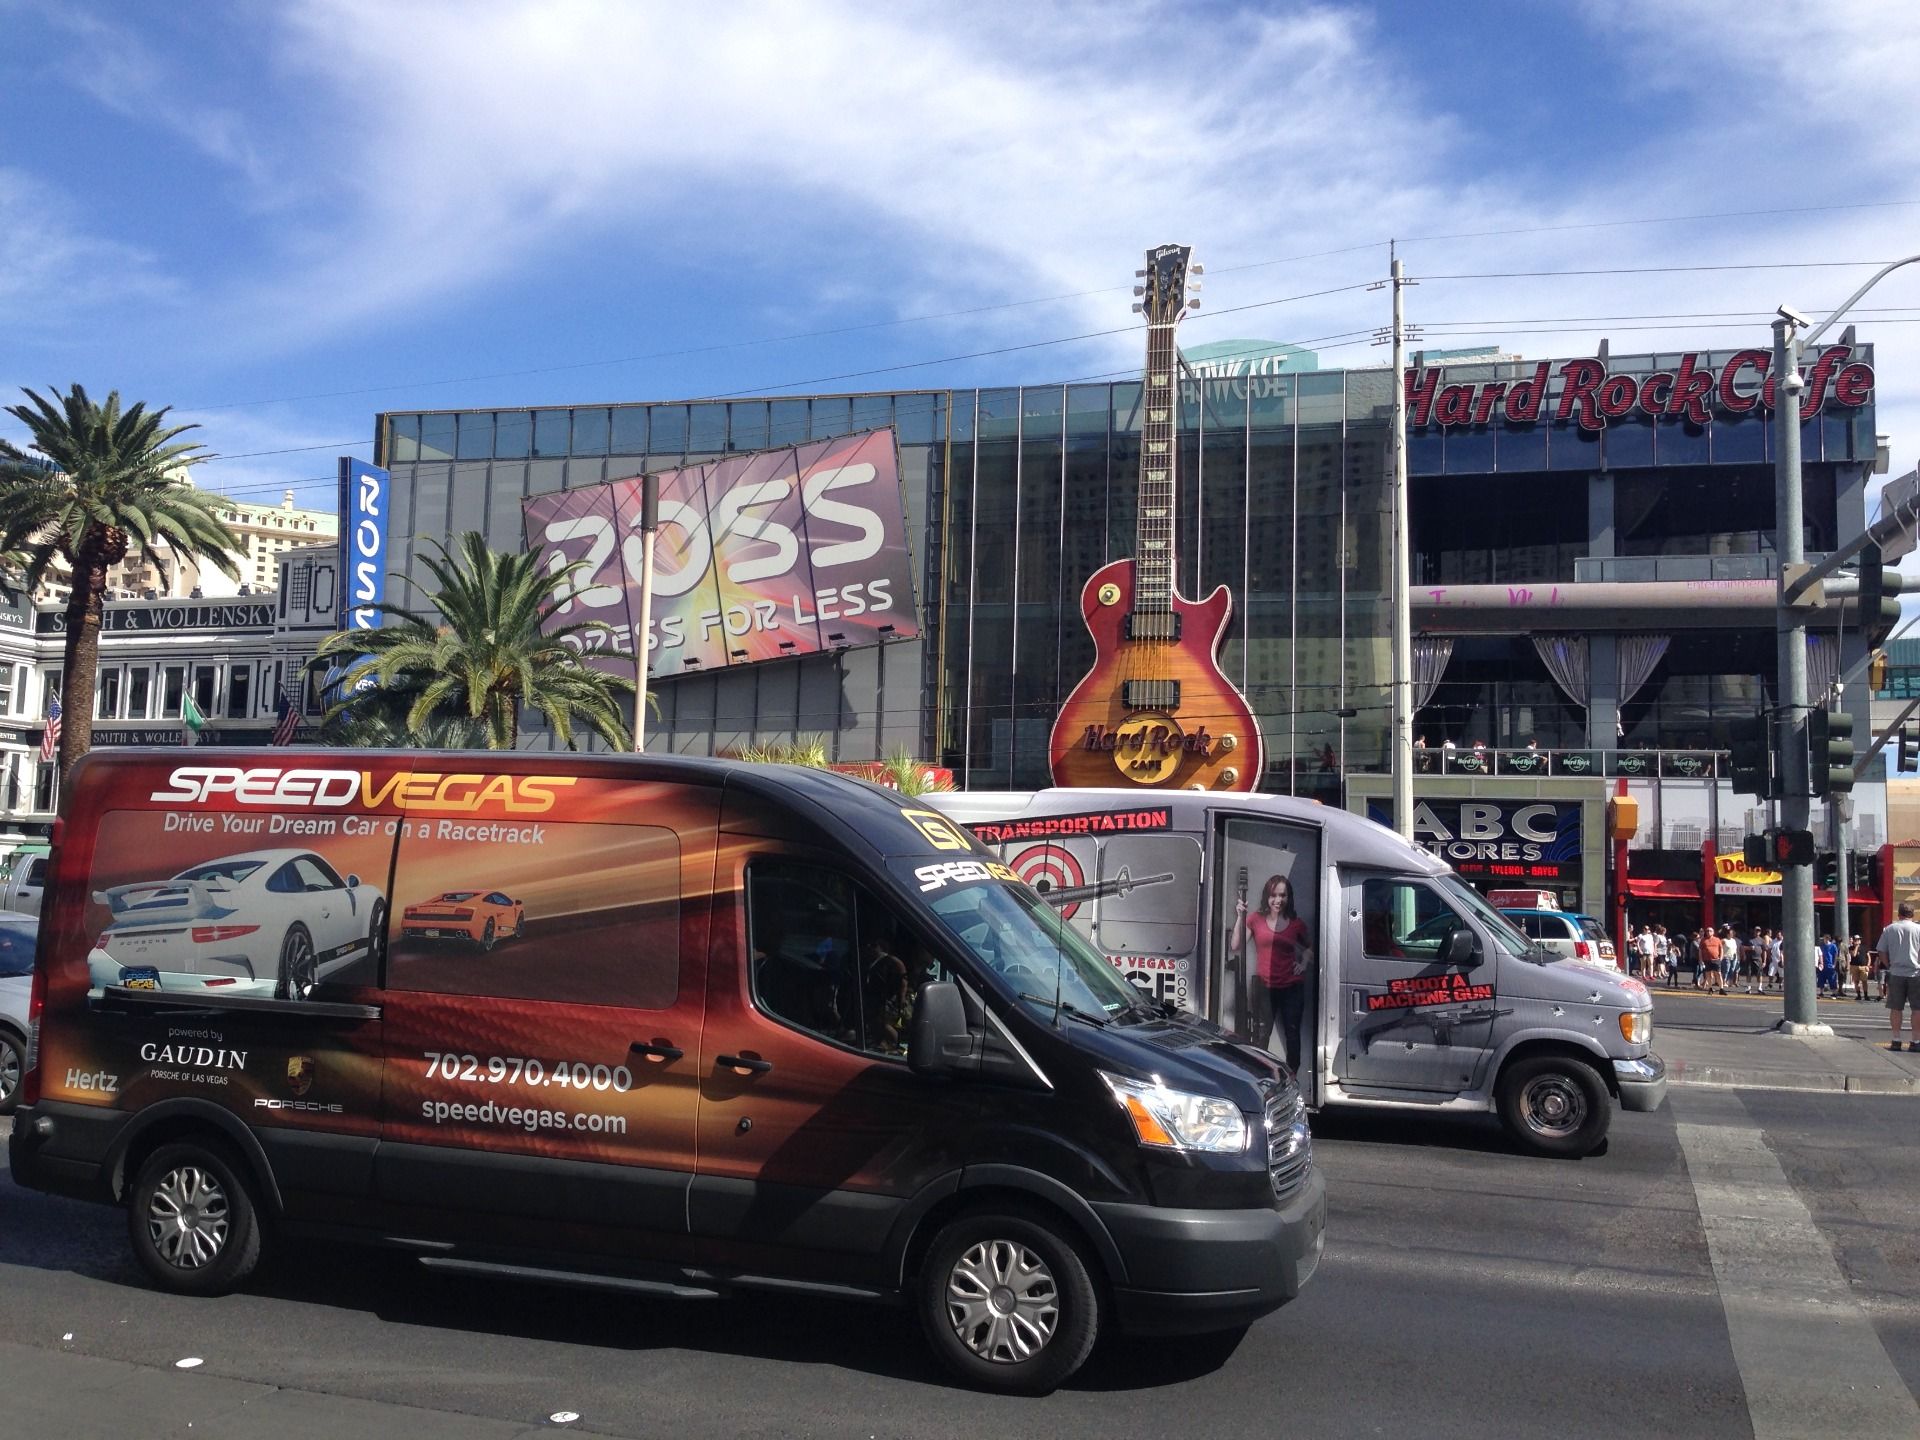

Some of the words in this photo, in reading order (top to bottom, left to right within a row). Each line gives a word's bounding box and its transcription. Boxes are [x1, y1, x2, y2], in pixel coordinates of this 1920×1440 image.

[1178, 355, 1289, 404] HOWCASE
[1404, 359, 1553, 427] Hard
[1555, 352, 1715, 430] Rock
[355, 474, 380, 629] ROSS
[545, 462, 885, 614] ROSS
[125, 611, 139, 629] &
[700, 601, 779, 641] FOR
[794, 578, 894, 625] LESS
[93, 733, 127, 743] SMITH
[132, 734, 139, 743] &
[1083, 724, 1148, 752] Hard
[1149, 725, 1212, 757] Rock
[1130, 759, 1162, 771] CAFE
[150, 766, 577, 812] SPEEDVEGAS
[164, 813, 214, 832] Drive
[220, 813, 266, 833] Your
[269, 815, 337, 835] Dream
[342, 816, 379, 836] Car
[385, 819, 411, 838] on
[417, 823, 431, 839] a
[437, 820, 544, 844] Racetrack
[974, 811, 1167, 841] TRANSPORTATION
[1413, 801, 1557, 842] ABC
[915, 861, 1020, 892] SPEEDVEG
[1490, 864, 1524, 876] TYLENOL
[1531, 866, 1559, 877] BAYER
[1720, 885, 1763, 894] AMERICA'S
[1767, 887, 1782, 895] DIN
[1105, 956, 1123, 967] AS
[1127, 956, 1176, 970] VEGAS
[1368, 989, 1450, 1010] MACHINE
[1453, 985, 1492, 1002] GUN
[1391, 975, 1449, 993] SHOOT
[1452, 973, 1467, 988] A
[168, 1028, 209, 1038] powered
[210, 1029, 223, 1042] by
[140, 1042, 249, 1071] GAUDIN
[64, 1068, 117, 1093] Hertz
[150, 1069, 180, 1081] PORSCHE
[181, 1072, 190, 1081] OF
[191, 1073, 205, 1083] LAS
[206, 1075, 229, 1086] VEGAS
[424, 1052, 633, 1093] 702.970.4000
[254, 1099, 344, 1113] PORSCHE
[421, 1100, 627, 1134] speedvegas.com
